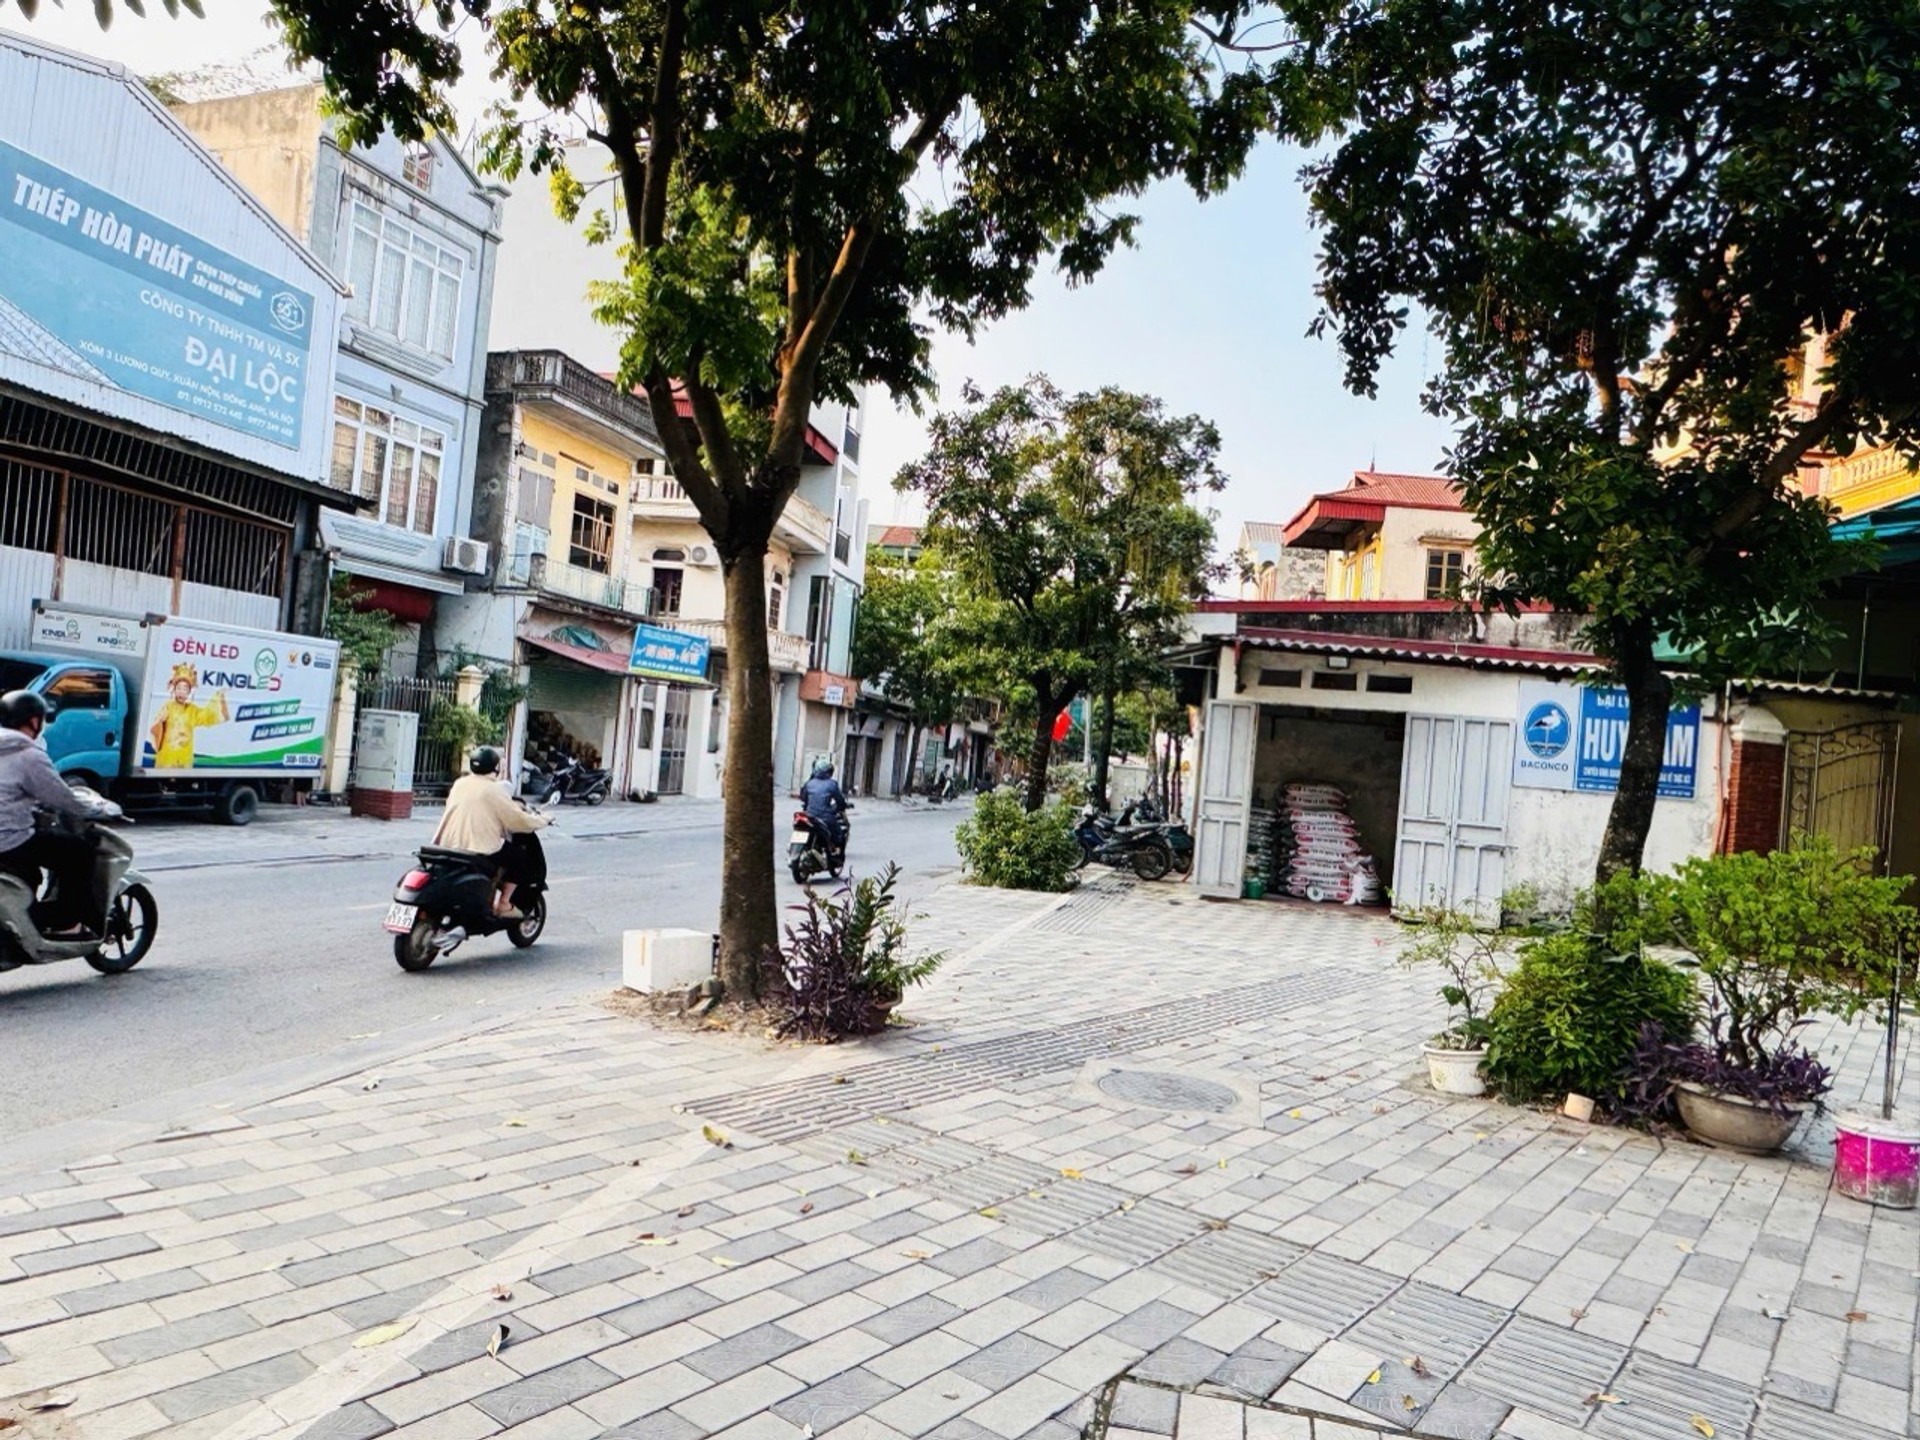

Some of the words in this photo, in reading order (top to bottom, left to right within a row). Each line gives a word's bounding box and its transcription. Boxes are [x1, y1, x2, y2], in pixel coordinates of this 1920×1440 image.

[13, 173, 81, 227] THÉP
[81, 207, 133, 256] HÒA
[134, 232, 195, 281] PHÁT
[140, 289, 185, 319] CÔNG
[187, 309, 206, 328] TY
[208, 317, 244, 344] TNHH
[245, 334, 265, 353] TM
[264, 342, 283, 360] VÀ
[284, 350, 301, 369] SX
[106, 351, 112, 360] 3
[184, 336, 237, 384] ĐẠI
[244, 360, 299, 404] LỘC
[172, 637, 207, 655] ĐÈN
[210, 642, 240, 660] LED
[202, 670, 281, 692] KINGLED
[1520, 759, 1569, 772] BACONCO
